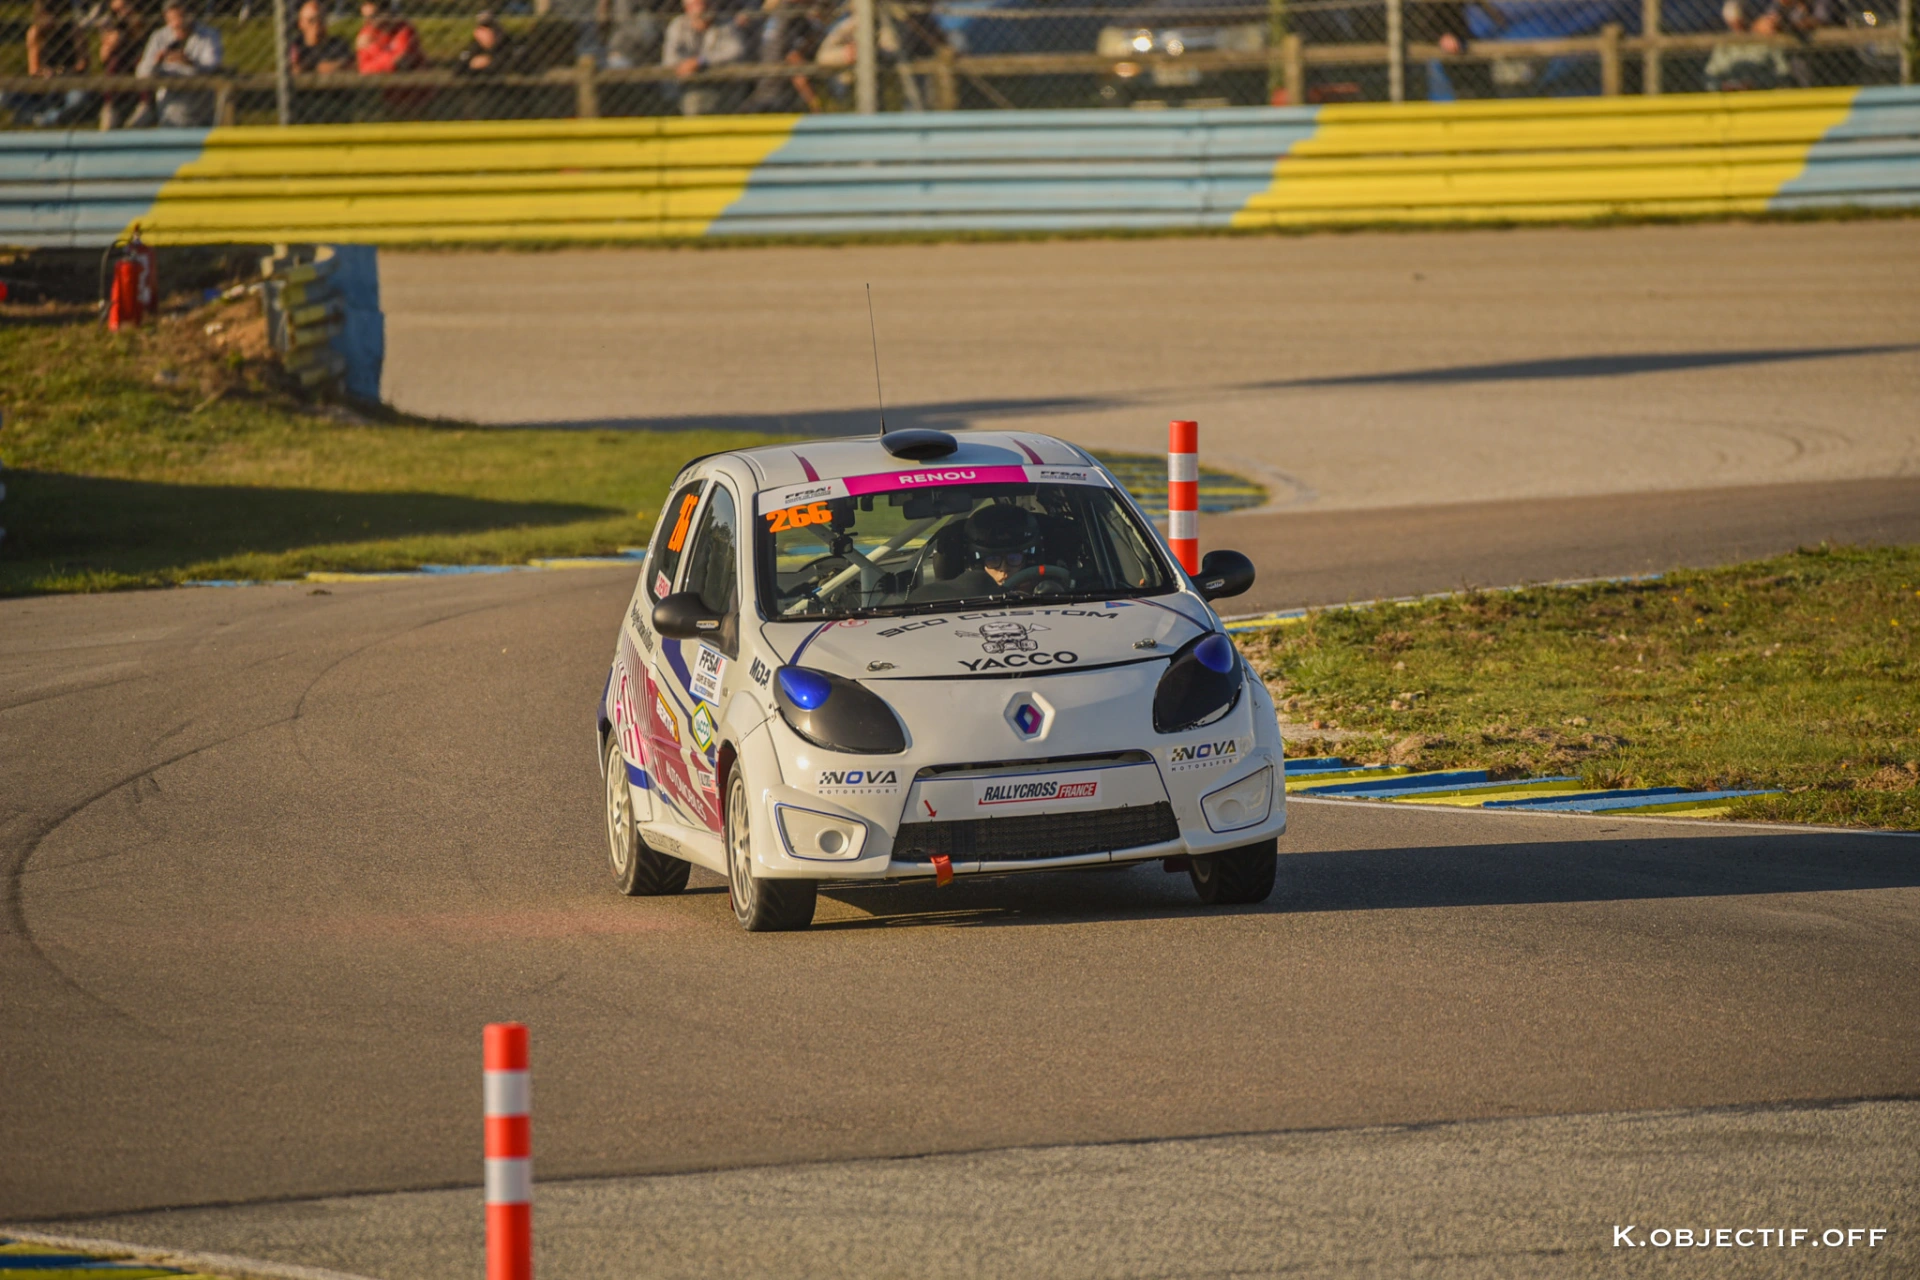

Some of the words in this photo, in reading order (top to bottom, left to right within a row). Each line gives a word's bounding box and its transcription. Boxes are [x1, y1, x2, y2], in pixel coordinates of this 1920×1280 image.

[899, 470, 977, 485] RENOU
[765, 501, 833, 533] 266
[957, 609, 1119, 621] CUSTOM
[699, 649, 719, 675] FFSA
[749, 656, 771, 687] MDA
[958, 651, 1079, 672] YACCO
[1172, 740, 1236, 762] NOVA
[819, 770, 897, 784] NOVA
[665, 759, 707, 821] AUTOMOBILES
[984, 781, 1058, 801] RALLYCROSS
[1060, 783, 1096, 798] FRANCE
